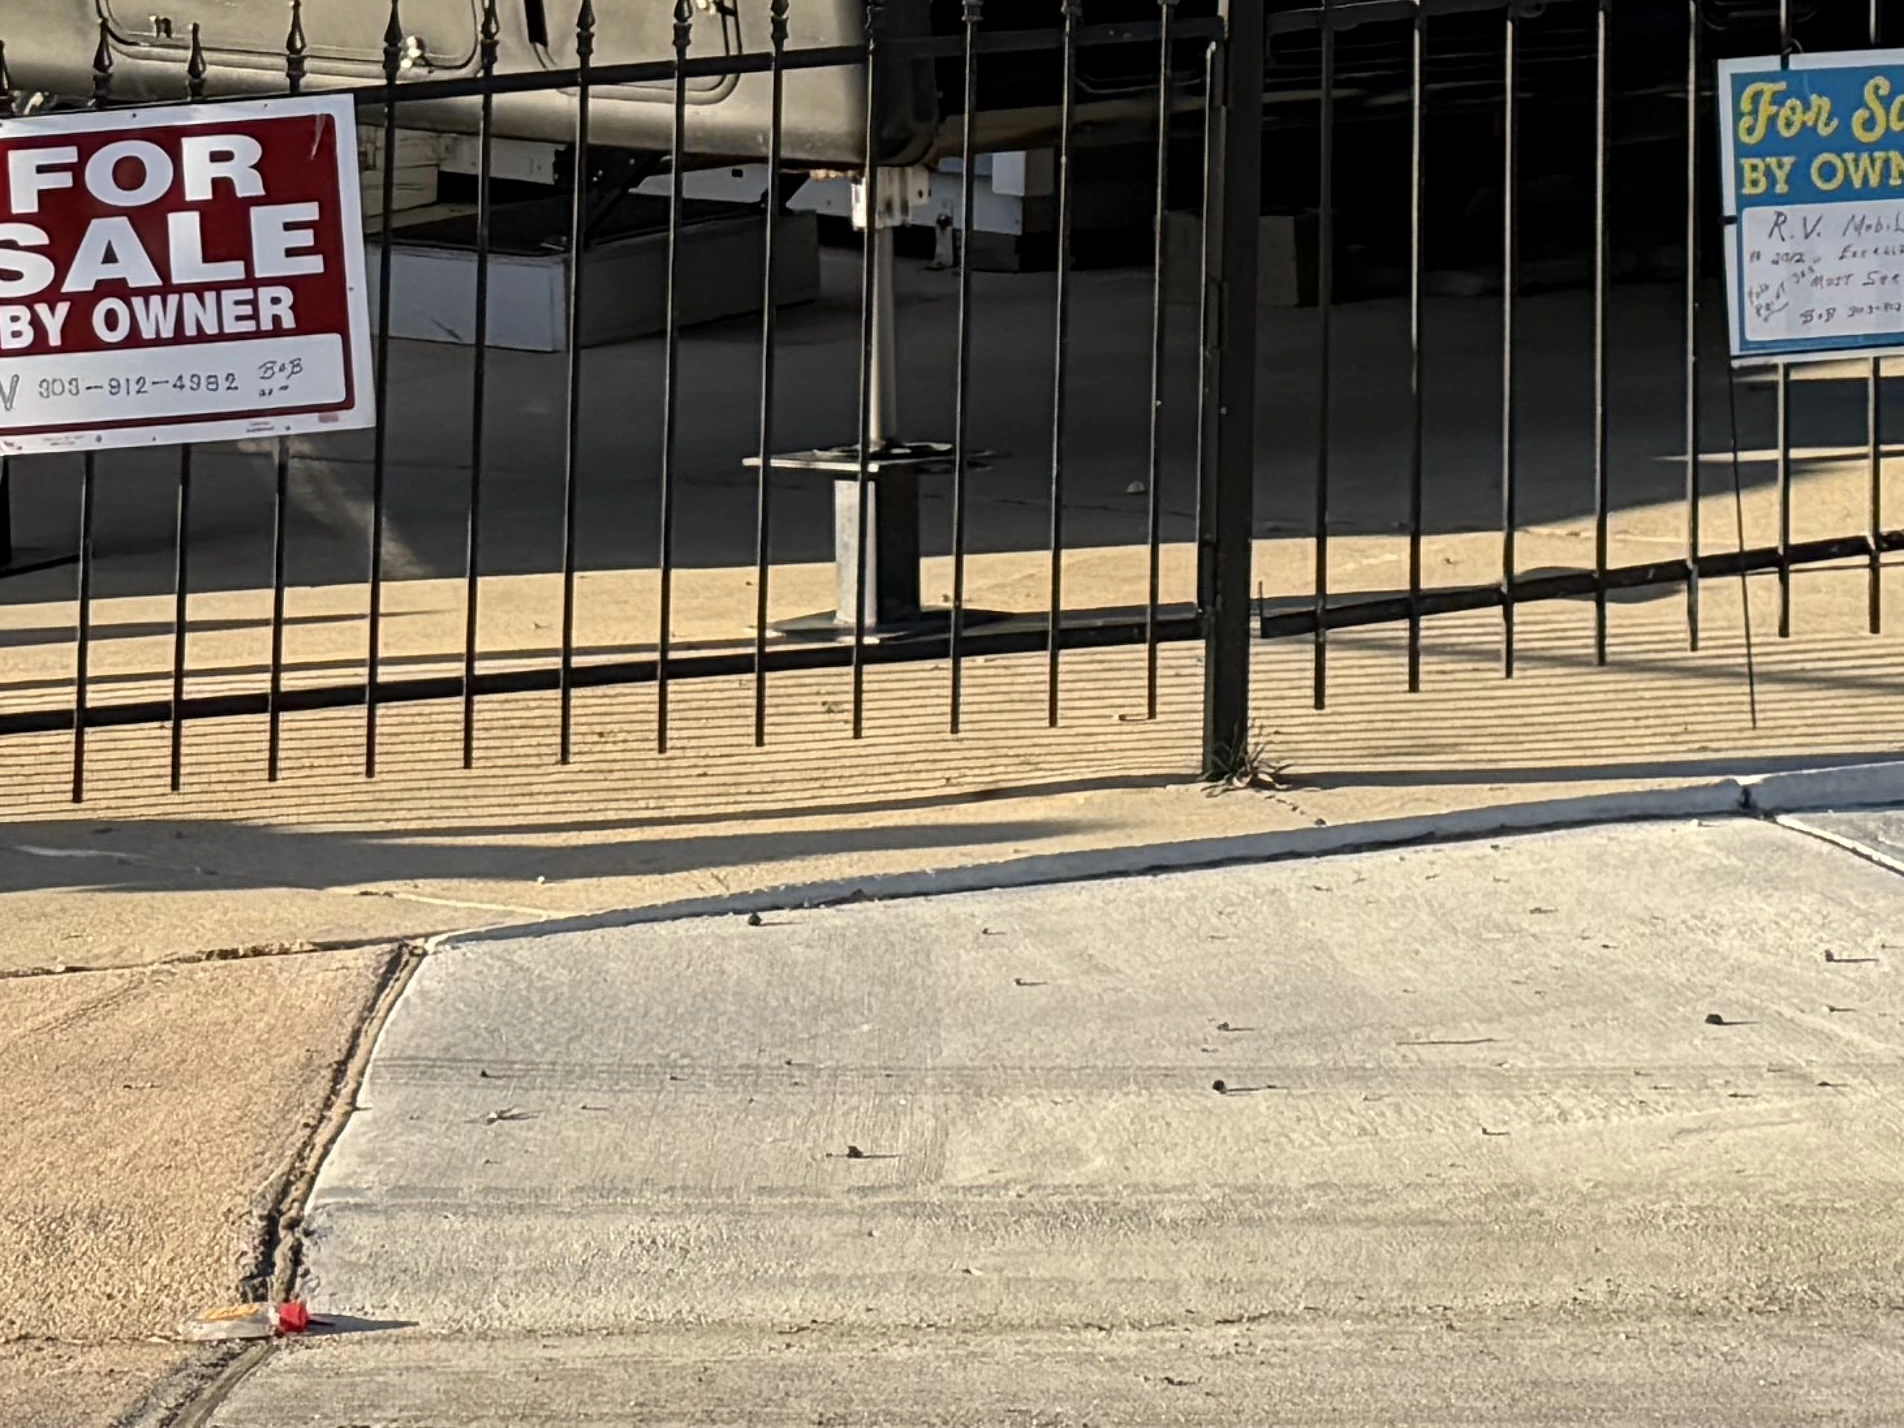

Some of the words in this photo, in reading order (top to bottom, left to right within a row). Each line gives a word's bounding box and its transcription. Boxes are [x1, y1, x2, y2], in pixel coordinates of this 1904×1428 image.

[1738, 81, 1839, 145] For
[7, 134, 266, 214] FOR
[1740, 157, 1796, 195] BY
[92, 285, 296, 343] OWNER
